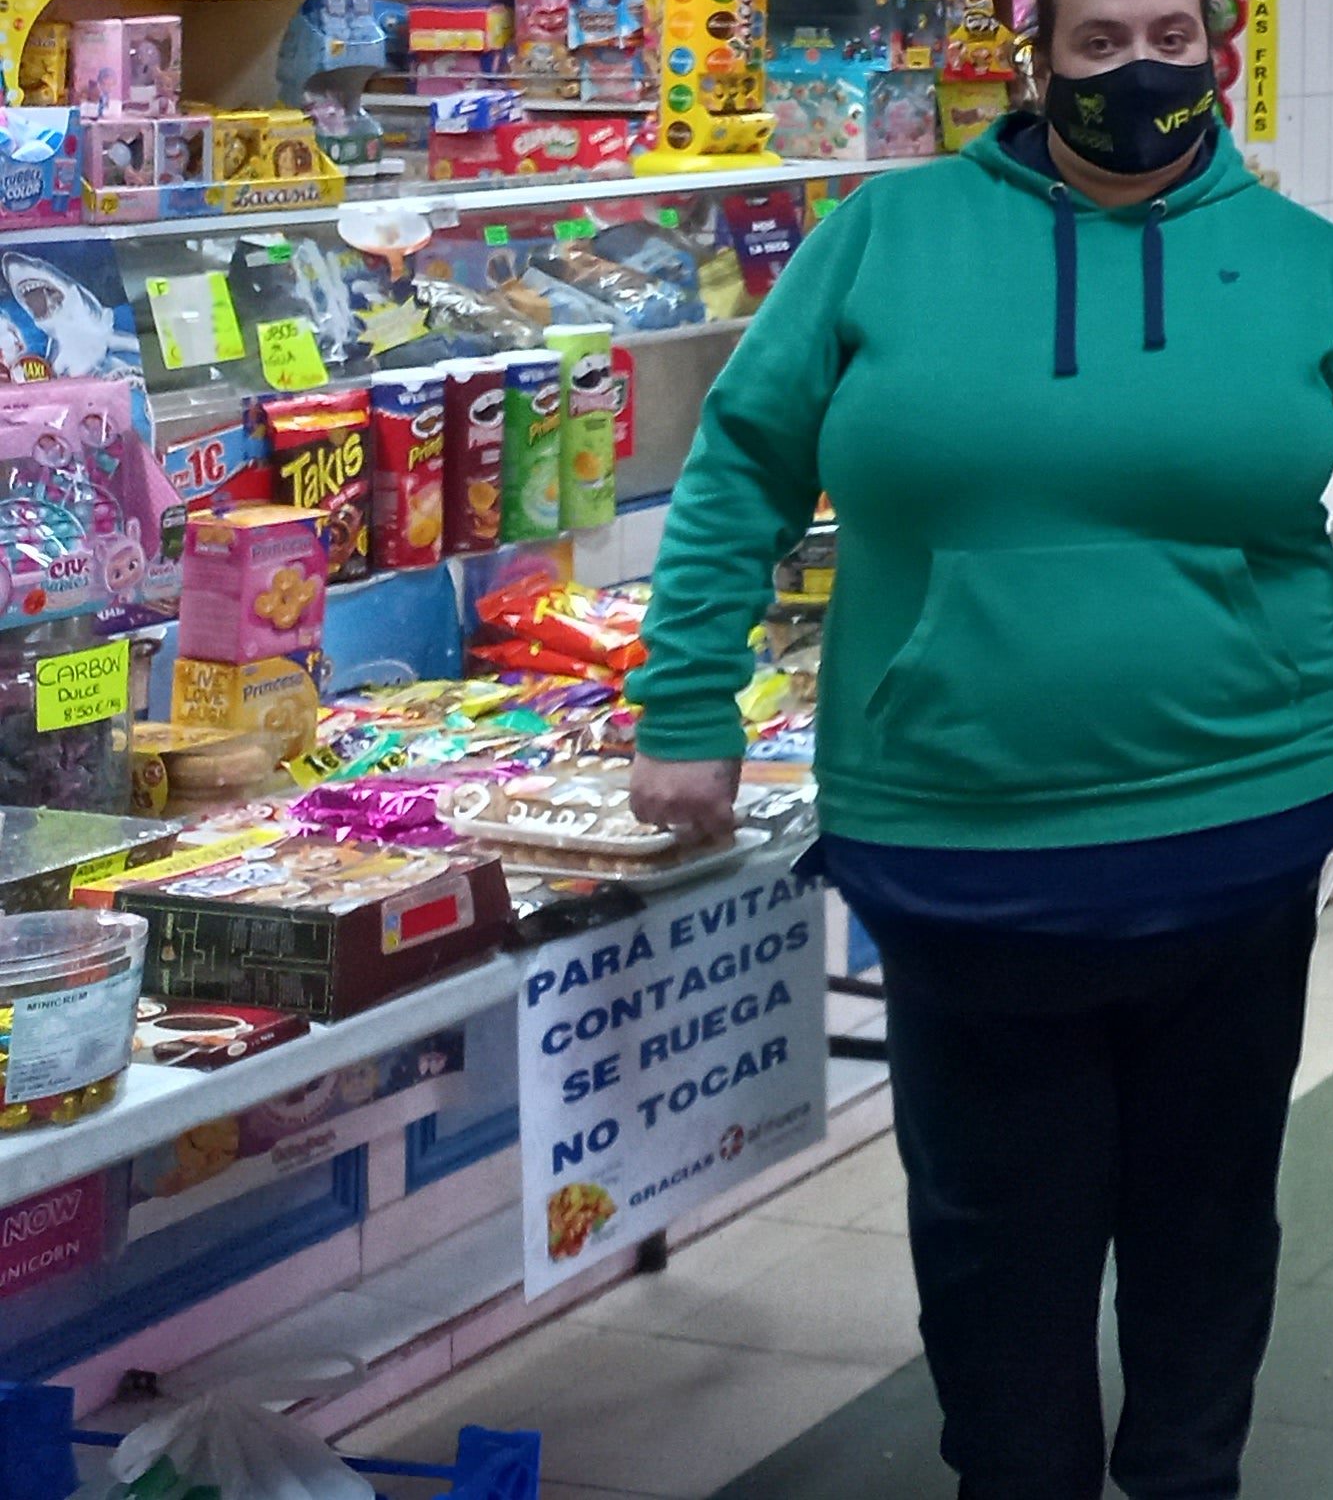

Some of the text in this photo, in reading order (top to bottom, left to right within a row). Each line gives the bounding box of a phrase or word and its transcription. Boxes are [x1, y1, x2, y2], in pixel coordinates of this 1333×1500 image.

[58, 683, 100, 703] DULCE
[541, 921, 809, 1056] CONTAGIOS
[562, 980, 792, 1104] SE RUEGA
[552, 1118, 620, 1175] NO
[637, 1035, 789, 1130] TOCAR
